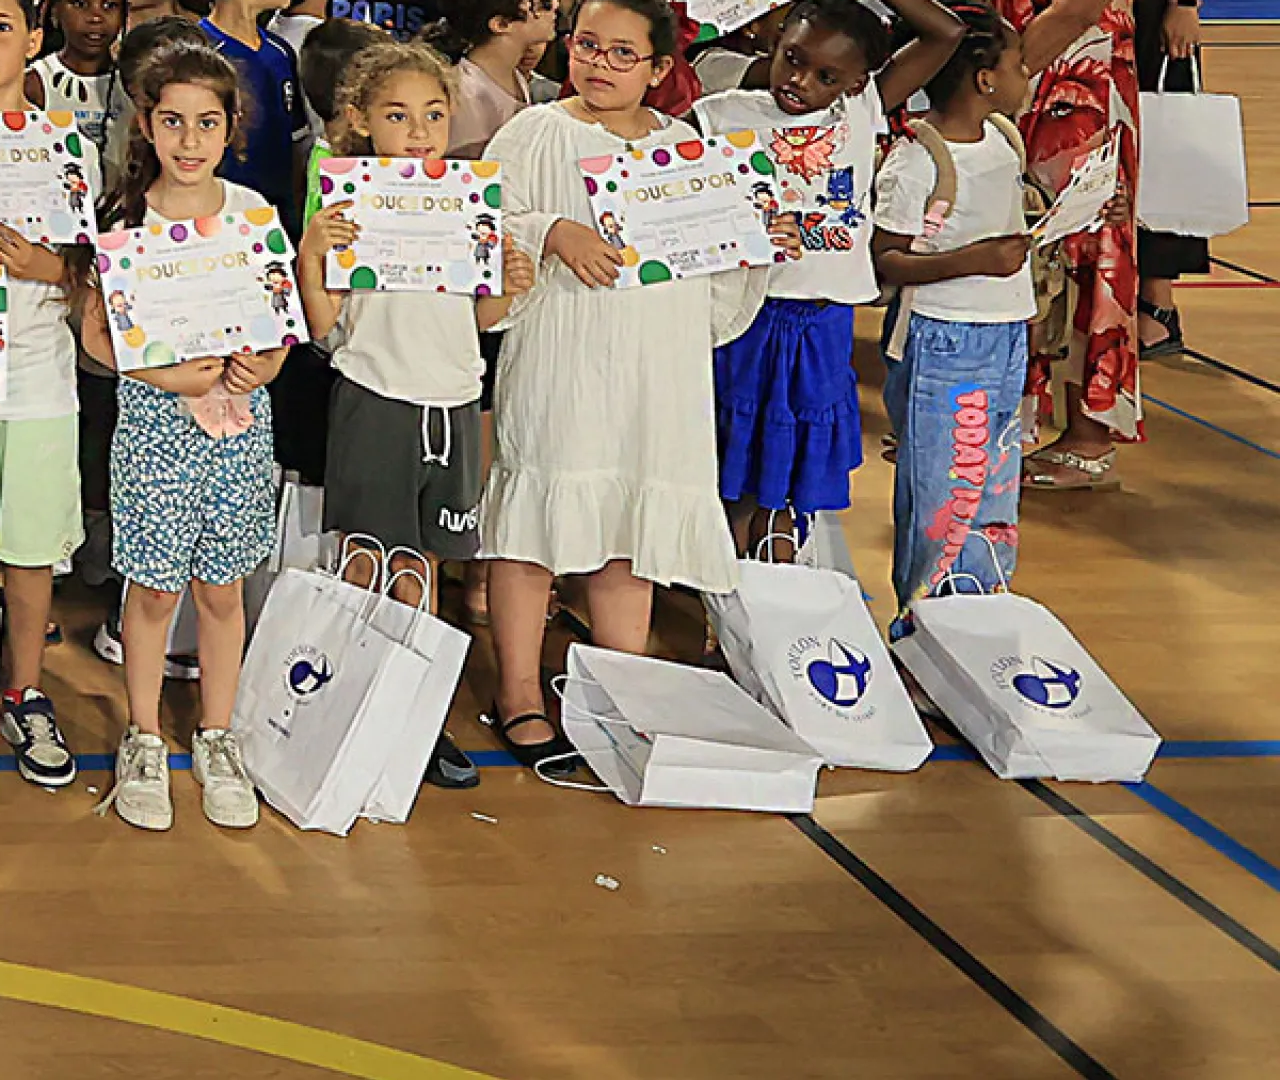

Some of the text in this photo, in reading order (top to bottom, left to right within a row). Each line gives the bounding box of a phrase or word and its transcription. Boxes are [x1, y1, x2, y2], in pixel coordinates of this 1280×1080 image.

[10, 148, 51, 163] D'OR
[689, 172, 737, 192] D'OR
[423, 196, 463, 212] D'OR
[200, 251, 248, 271] D'OR
[949, 389, 989, 487] TODAY
